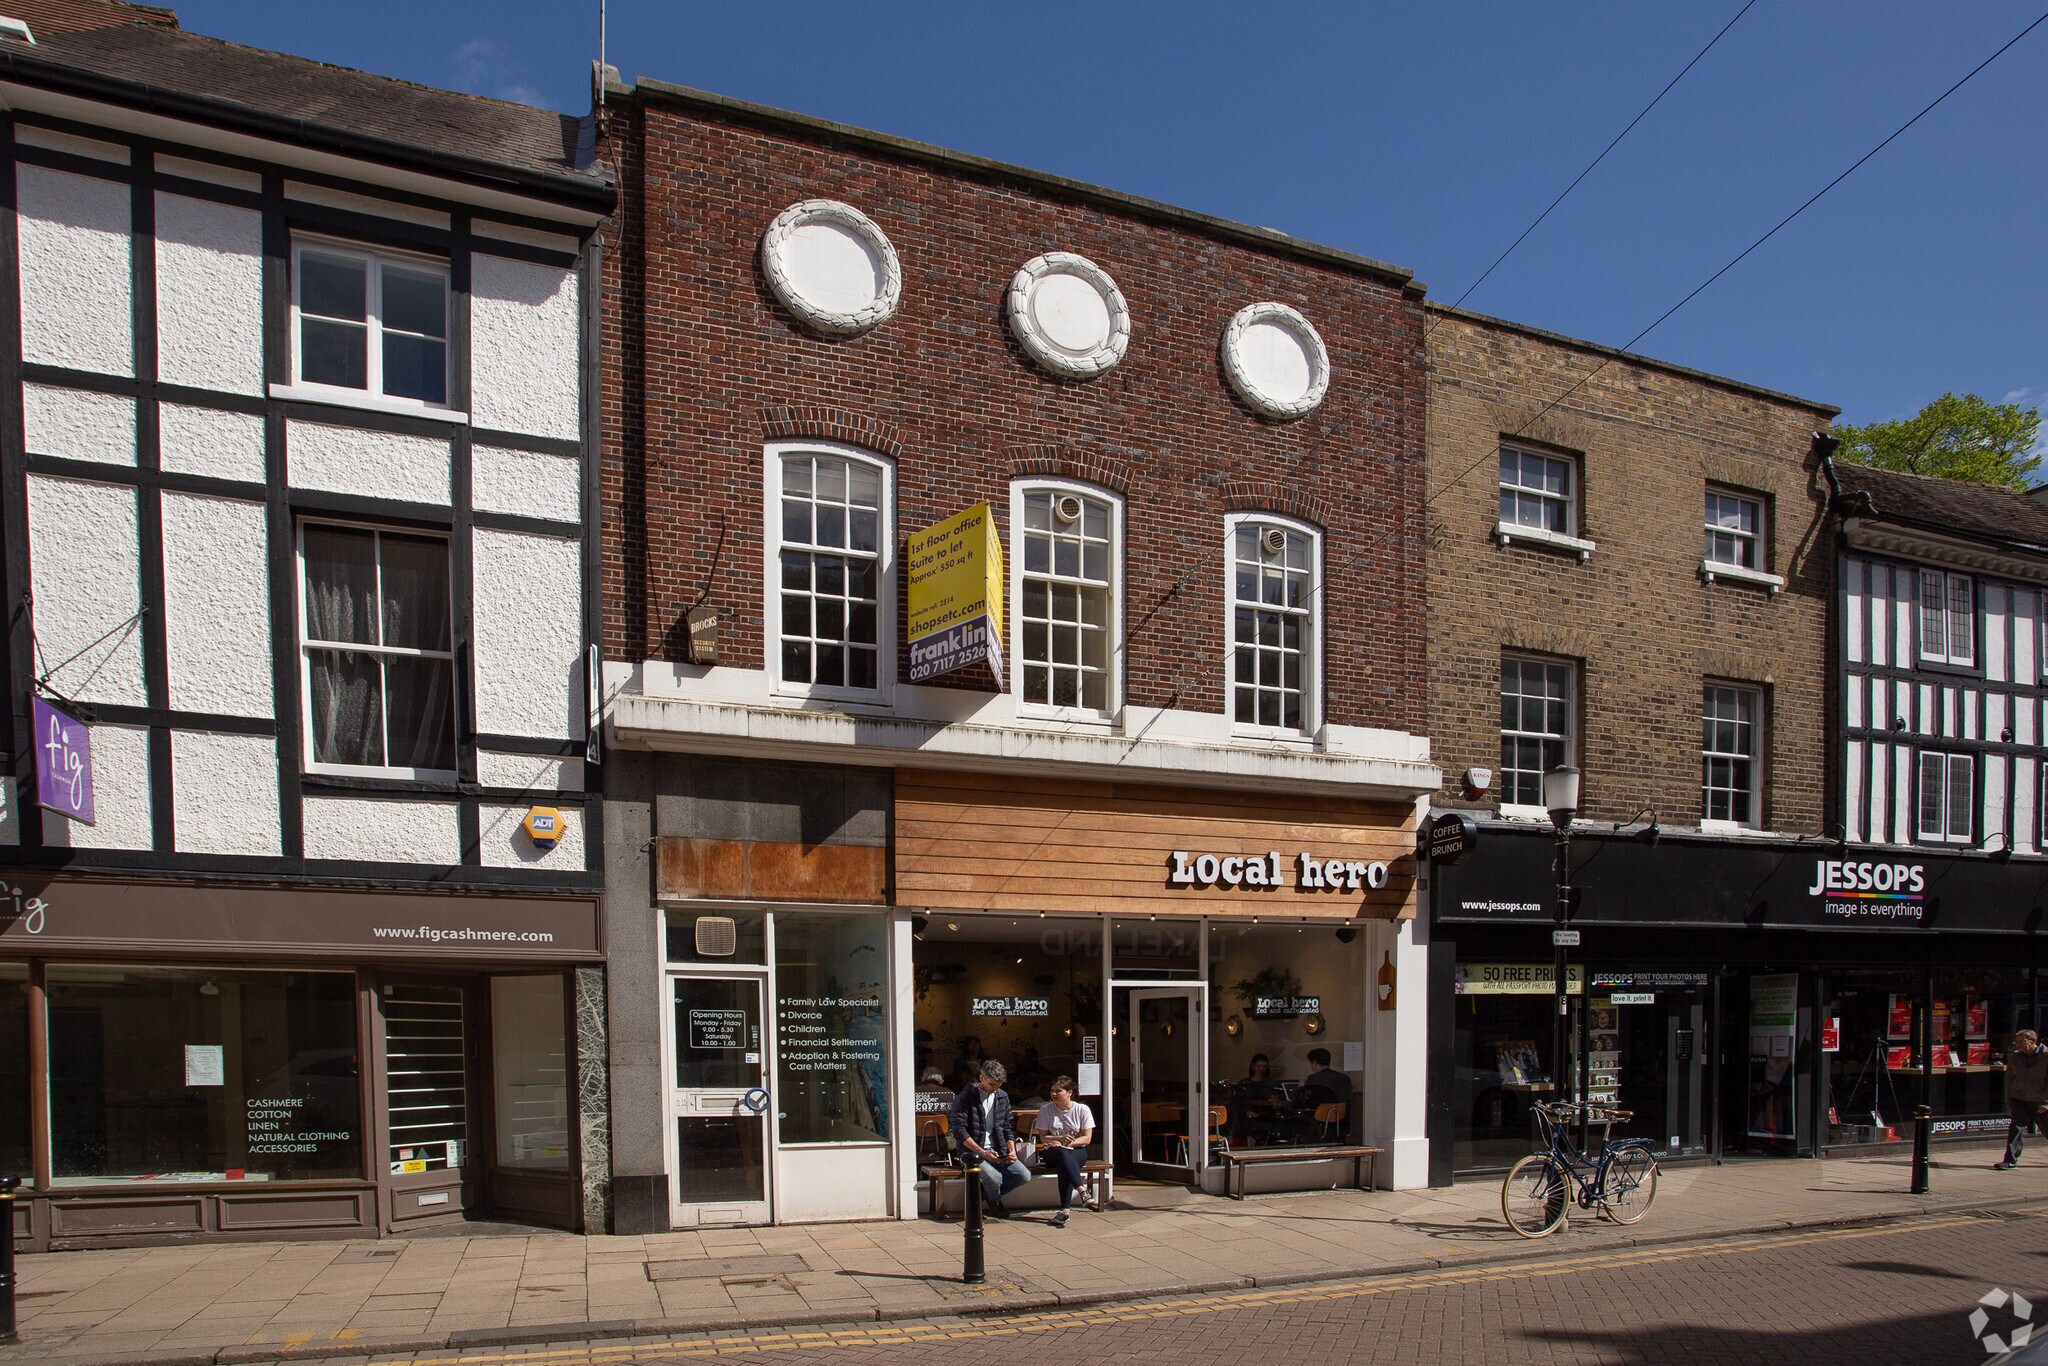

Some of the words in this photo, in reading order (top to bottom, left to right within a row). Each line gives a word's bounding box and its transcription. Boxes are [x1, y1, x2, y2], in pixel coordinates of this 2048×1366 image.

[911, 543, 924, 555] 1st
[927, 530, 950, 548] floor
[953, 516, 982, 535] office
[910, 553, 934, 572] Suite
[936, 549, 947, 560] to
[950, 540, 963, 554] let
[940, 559, 955, 572] 550
[956, 554, 966, 565] sq
[967, 550, 973, 560] ft
[940, 595, 954, 607] 2514
[910, 599, 986, 635] shopsetc.com
[690, 616, 717, 634] BROCKS
[910, 623, 986, 666] franklin
[910, 663, 930, 681] 020
[933, 654, 955, 673] 7117
[958, 643, 986, 664] 2526
[45, 714, 84, 811] fig
[532, 818, 554, 829] ADT
[1433, 823, 1461, 839] COFFEE
[1431, 841, 1463, 857] BRUNCH
[1172, 851, 1284, 885] Local
[1301, 852, 1389, 889] hero
[1809, 860, 1925, 896] JESSOPS
[1461, 900, 1541, 913] www.jessops.com
[1825, 900, 1857, 917] image
[1860, 901, 1868, 915] is
[1870, 903, 1923, 919] everything
[373, 925, 554, 942] www.figcashmere.com
[1483, 967, 1500, 980] 50
[1504, 967, 1531, 980] FREE
[1535, 967, 1576, 981] PRIS
[1591, 973, 1633, 986] JESSOPS
[1669, 973, 1692, 981] PHOTOS
[1693, 973, 1708, 981] HERE
[787, 997, 816, 1007] Family
[818, 998, 836, 1006] Law
[838, 998, 879, 1008] Specialist
[973, 997, 1010, 1010] Local
[1014, 997, 1048, 1010] hero
[1257, 997, 1289, 1009] Local
[1291, 997, 1319, 1009] hero
[1633, 995, 1647, 1003] print
[692, 1011, 723, 1019] Opening
[787, 1011, 823, 1019] Divorce
[788, 1024, 826, 1033] Children
[788, 1038, 829, 1046] Financial
[831, 1038, 877, 1046] Settlement
[788, 1052, 830, 1061] Adoption
[841, 1051, 880, 1061] Fostering
[789, 1062, 812, 1070] Care
[814, 1062, 847, 1070] Matters
[247, 1098, 303, 1108] CASHMERE
[915, 1102, 954, 1110] COFFEE
[247, 1110, 292, 1119] COTTON
[248, 1122, 279, 1130] LINEN
[1931, 1120, 1966, 1133] JESSOPS
[248, 1133, 296, 1142] NATURAL
[298, 1131, 350, 1141] CLOTHING
[248, 1143, 318, 1154] ACCESSORIES
